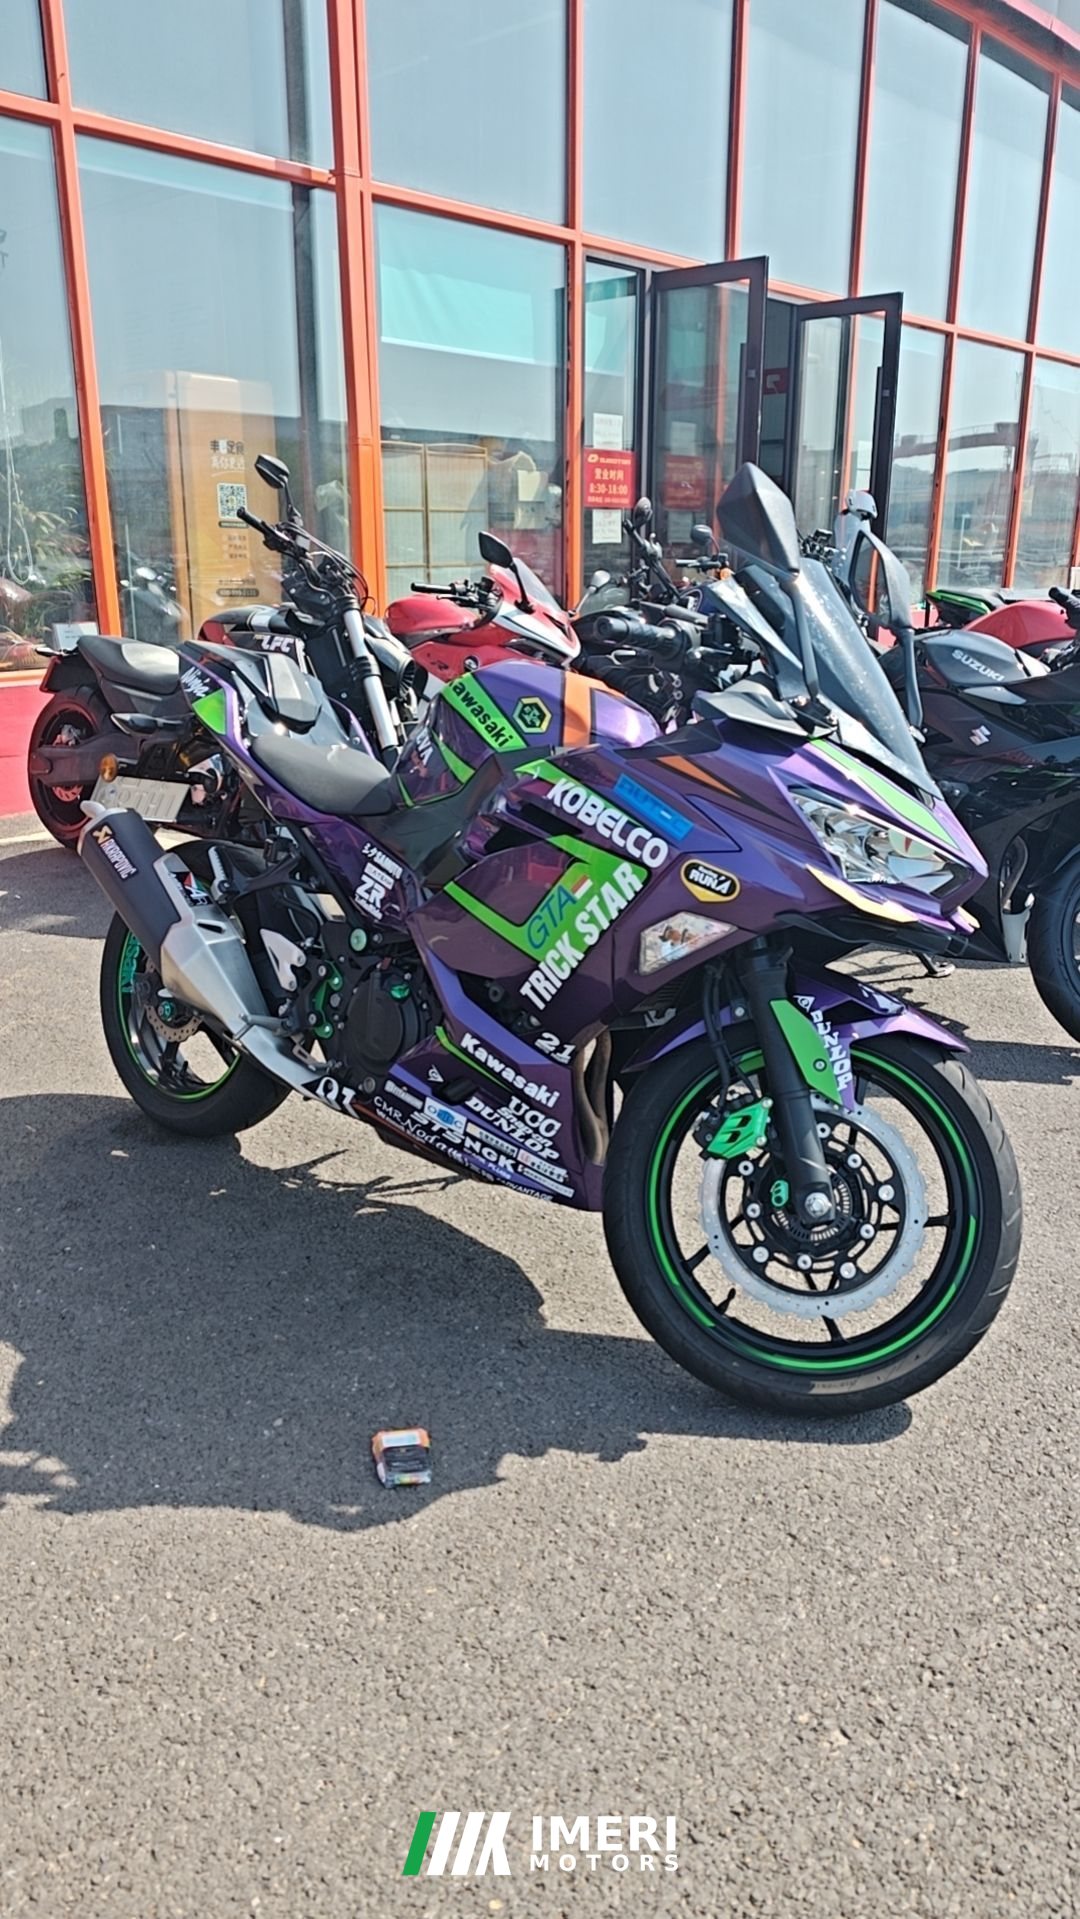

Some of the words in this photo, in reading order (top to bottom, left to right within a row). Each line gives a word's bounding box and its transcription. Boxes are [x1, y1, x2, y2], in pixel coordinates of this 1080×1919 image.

[951, 649, 1006, 682] SUZUKI
[449, 680, 514, 748] awasaki
[547, 778, 669, 869] KOBELCO
[519, 931, 585, 1011] TRICK
[574, 861, 644, 946] STAR
[527, 885, 578, 950] GTA
[460, 1032, 561, 1109] Kawasaki
[810, 1009, 853, 1092] DUNLOP
[463, 1136, 517, 1173] NGK
[464, 1096, 560, 1161] DUNLOP
